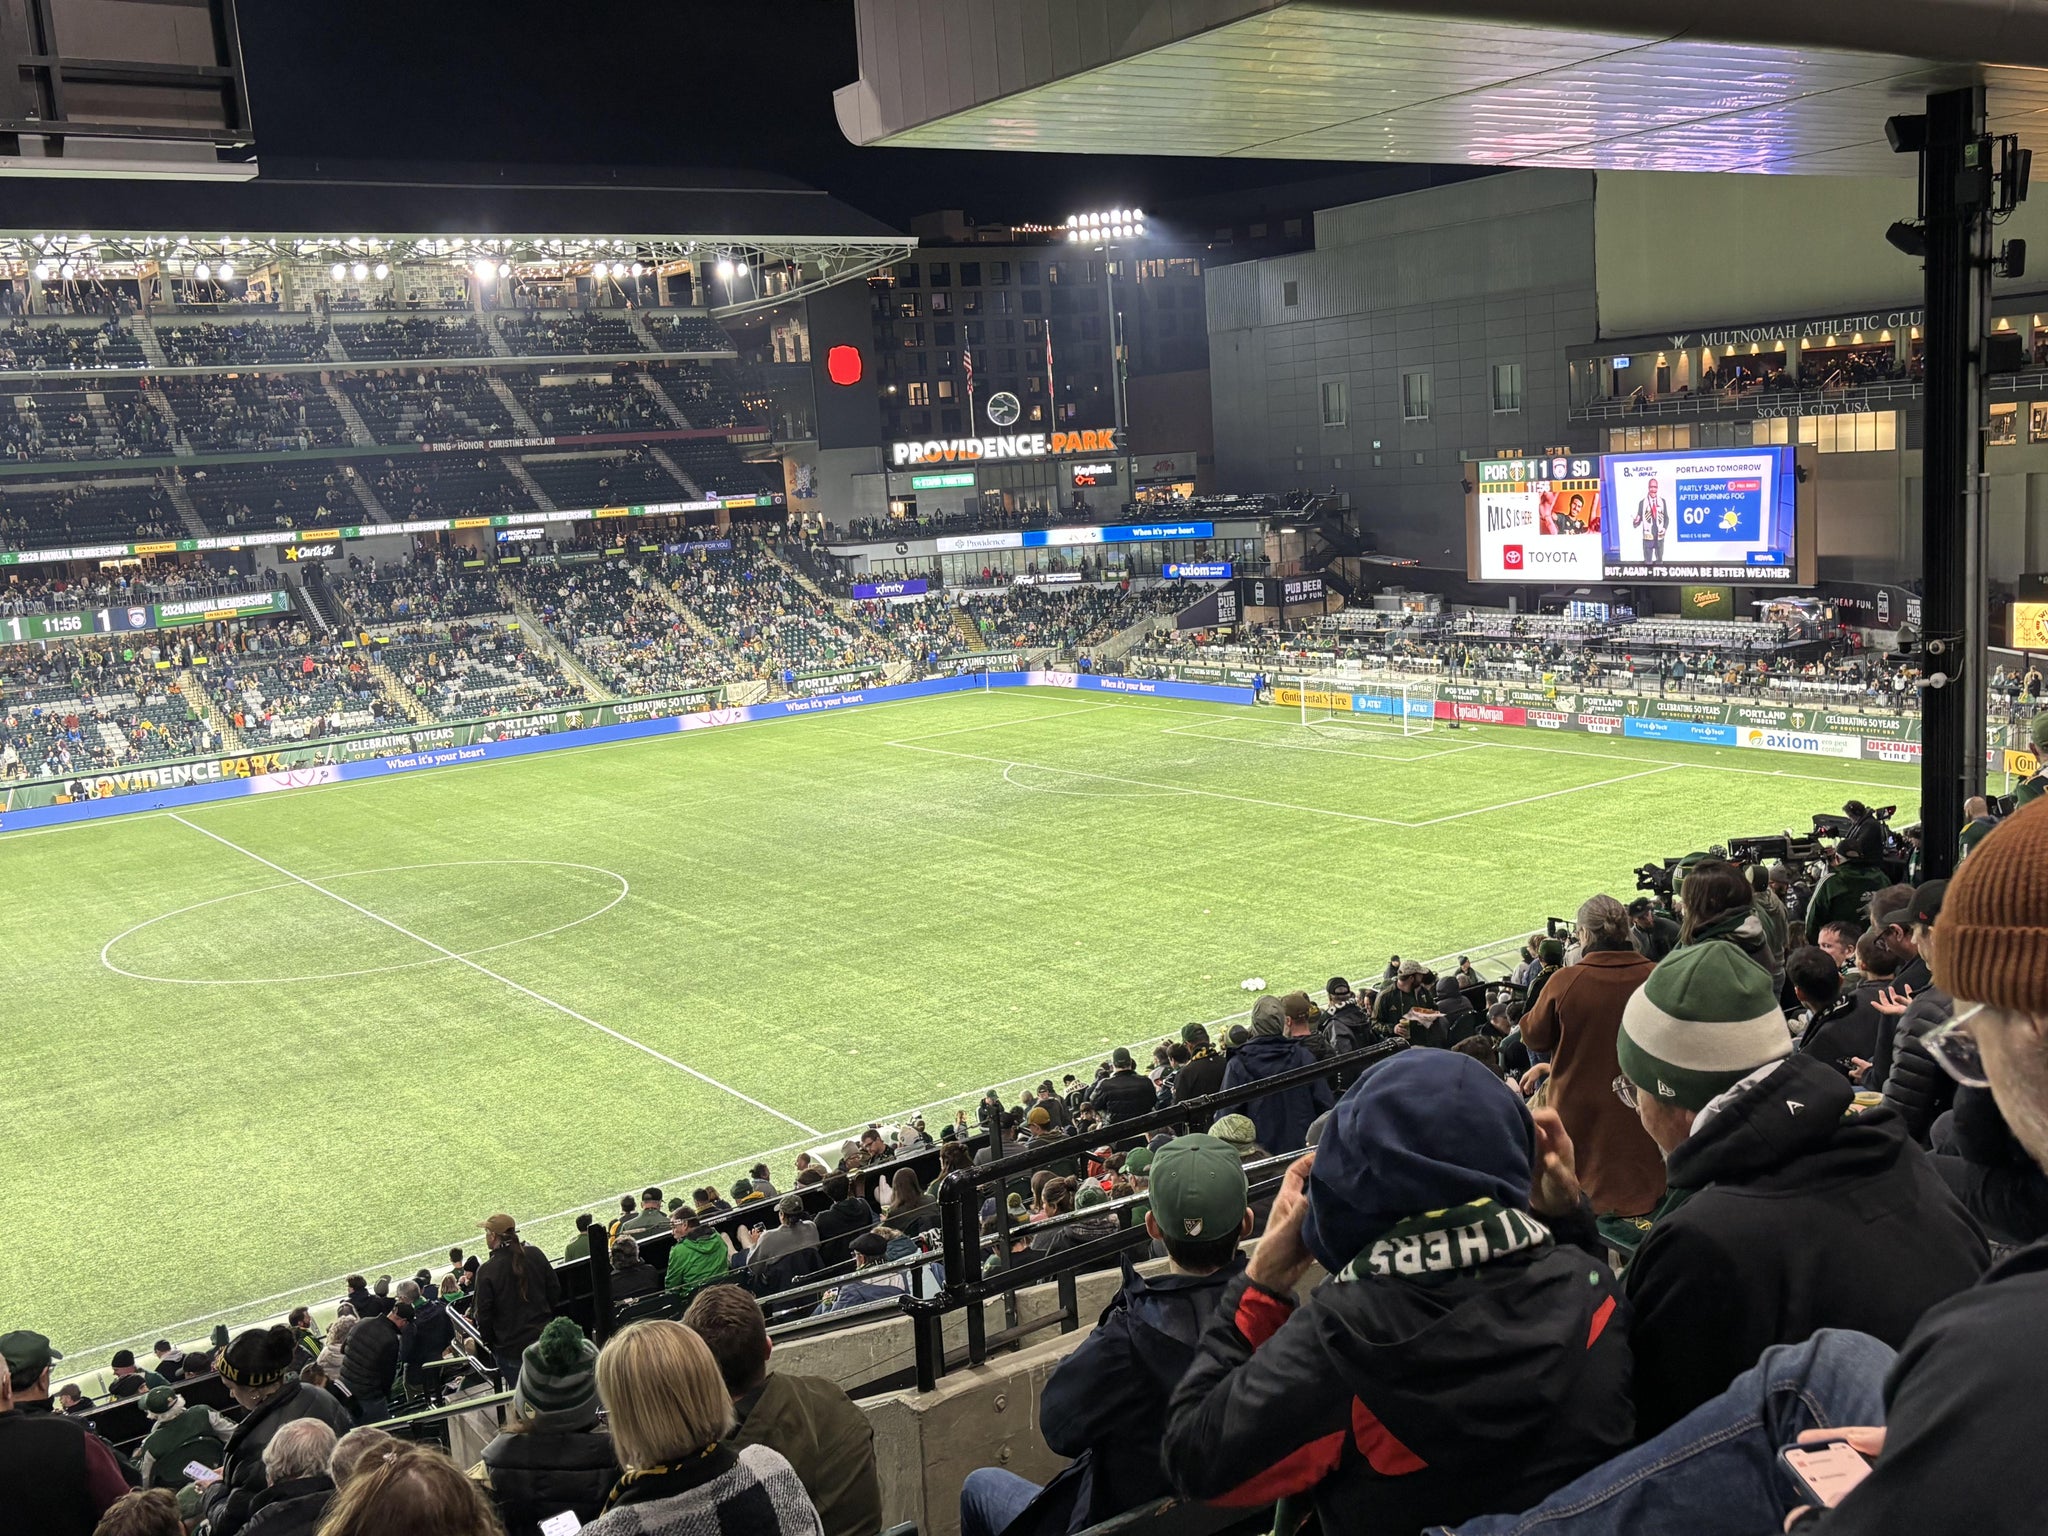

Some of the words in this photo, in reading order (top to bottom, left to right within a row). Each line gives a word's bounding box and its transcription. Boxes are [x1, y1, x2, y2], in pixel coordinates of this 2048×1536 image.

[1701, 325, 1797, 347] MULTNOMAH
[1802, 313, 1880, 337] ATHLETIC
[1887, 310, 1925, 328] CLU
[1757, 406, 1804, 418] SOCCER
[1810, 404, 1840, 416] CITY
[1845, 402, 1871, 413] USA
[432, 442, 452, 452] RING
[458, 440, 484, 451] HONOR
[488, 438, 524, 449] CHRISTINE
[524, 437, 556, 447] SINCLAIR
[892, 434, 1047, 466] PROVIDENCE
[1050, 428, 1118, 454] PARK
[1074, 464, 1113, 476] KeyBank
[1484, 464, 1508, 480] POR
[1527, 460, 1535, 479] 1
[1540, 460, 1548, 478] 1
[1572, 460, 1590, 477] SD
[1676, 466, 1714, 474] PORTLAND
[1716, 464, 1762, 472] TOMORROW
[1680, 484, 1702, 492] PARTLY
[1488, 505, 1512, 532] MLS
[1514, 509, 1520, 527] IS
[1683, 507, 1710, 524] 60°
[1132, 528, 1152, 536] When
[1163, 529, 1177, 537] your
[1178, 527, 1195, 535] heart
[966, 537, 1006, 548] Providence
[298, 547, 322, 558] Carl's
[322, 544, 336, 557] Jr.
[1528, 552, 1578, 563] TOYOTA
[1179, 564, 1210, 576] axiom
[1604, 566, 1622, 578] BUT,
[1623, 566, 1648, 577] AGAIN
[1652, 567, 1667, 578] IT'S
[1668, 567, 1699, 578] GONNA
[1700, 567, 1712, 578] BE
[1713, 567, 1745, 578] BETTER
[1746, 568, 1790, 579] WEATHER
[875, 584, 904, 594] xfinity
[1285, 582, 1300, 595] PUB
[1302, 579, 1322, 592] BEER
[1218, 596, 1236, 608] PUB
[1286, 593, 1308, 603] CHEAP
[1310, 592, 1325, 600] FUN.
[1829, 597, 1854, 607] CHEAP
[1856, 600, 1874, 610] FUN.
[161, 604, 184, 616] 2026
[185, 600, 217, 614] ANNUAL
[218, 594, 272, 610] MEMBERSHIPS
[1907, 604, 1921, 617] PUB
[1218, 608, 1236, 618] BEER
[8, 618, 22, 640] 1
[42, 616, 82, 632] 11:56
[98, 609, 110, 632] 1
[986, 656, 997, 665] 50
[798, 674, 854, 690] PORTLAND
[1101, 678, 1116, 688] When
[1117, 680, 1125, 690] it's
[1125, 682, 1139, 692] your
[1139, 682, 1155, 692] heart
[786, 701, 810, 711] When
[810, 699, 822, 708] it's
[823, 698, 842, 709] your
[842, 694, 863, 704] heart
[1512, 692, 1543, 702] CELEBRATING
[1582, 697, 1623, 708] PORTLAND
[613, 698, 667, 715] CELEBRATING
[668, 698, 680, 708] 50
[680, 694, 706, 706] YEARS
[1367, 700, 1382, 708] AT&T
[1657, 702, 1692, 714] CELEBRATING
[1693, 704, 1701, 714] 50
[1701, 706, 1720, 715] YEARS
[1479, 705, 1504, 722] Morgan
[1528, 710, 1568, 722] DISCOUNT
[1740, 708, 1786, 720] PORTLAND
[1578, 714, 1621, 727] DISCOUNT
[1636, 722, 1648, 730] First
[1826, 716, 1868, 728] CELEBRATING
[1868, 718, 1878, 728] 50
[1878, 719, 1900, 729] YEARS
[1691, 726, 1704, 734] First
[1710, 728, 1725, 736] Tech
[346, 734, 410, 752] CELEBRATING
[424, 728, 454, 740] YEARS
[1767, 733, 1818, 750] axiom
[1834, 740, 1847, 748] pest
[1868, 741, 1922, 754] DISCOUNT
[386, 757, 416, 769] When
[418, 754, 433, 765] it's
[435, 752, 457, 764] your
[458, 748, 486, 760] heart
